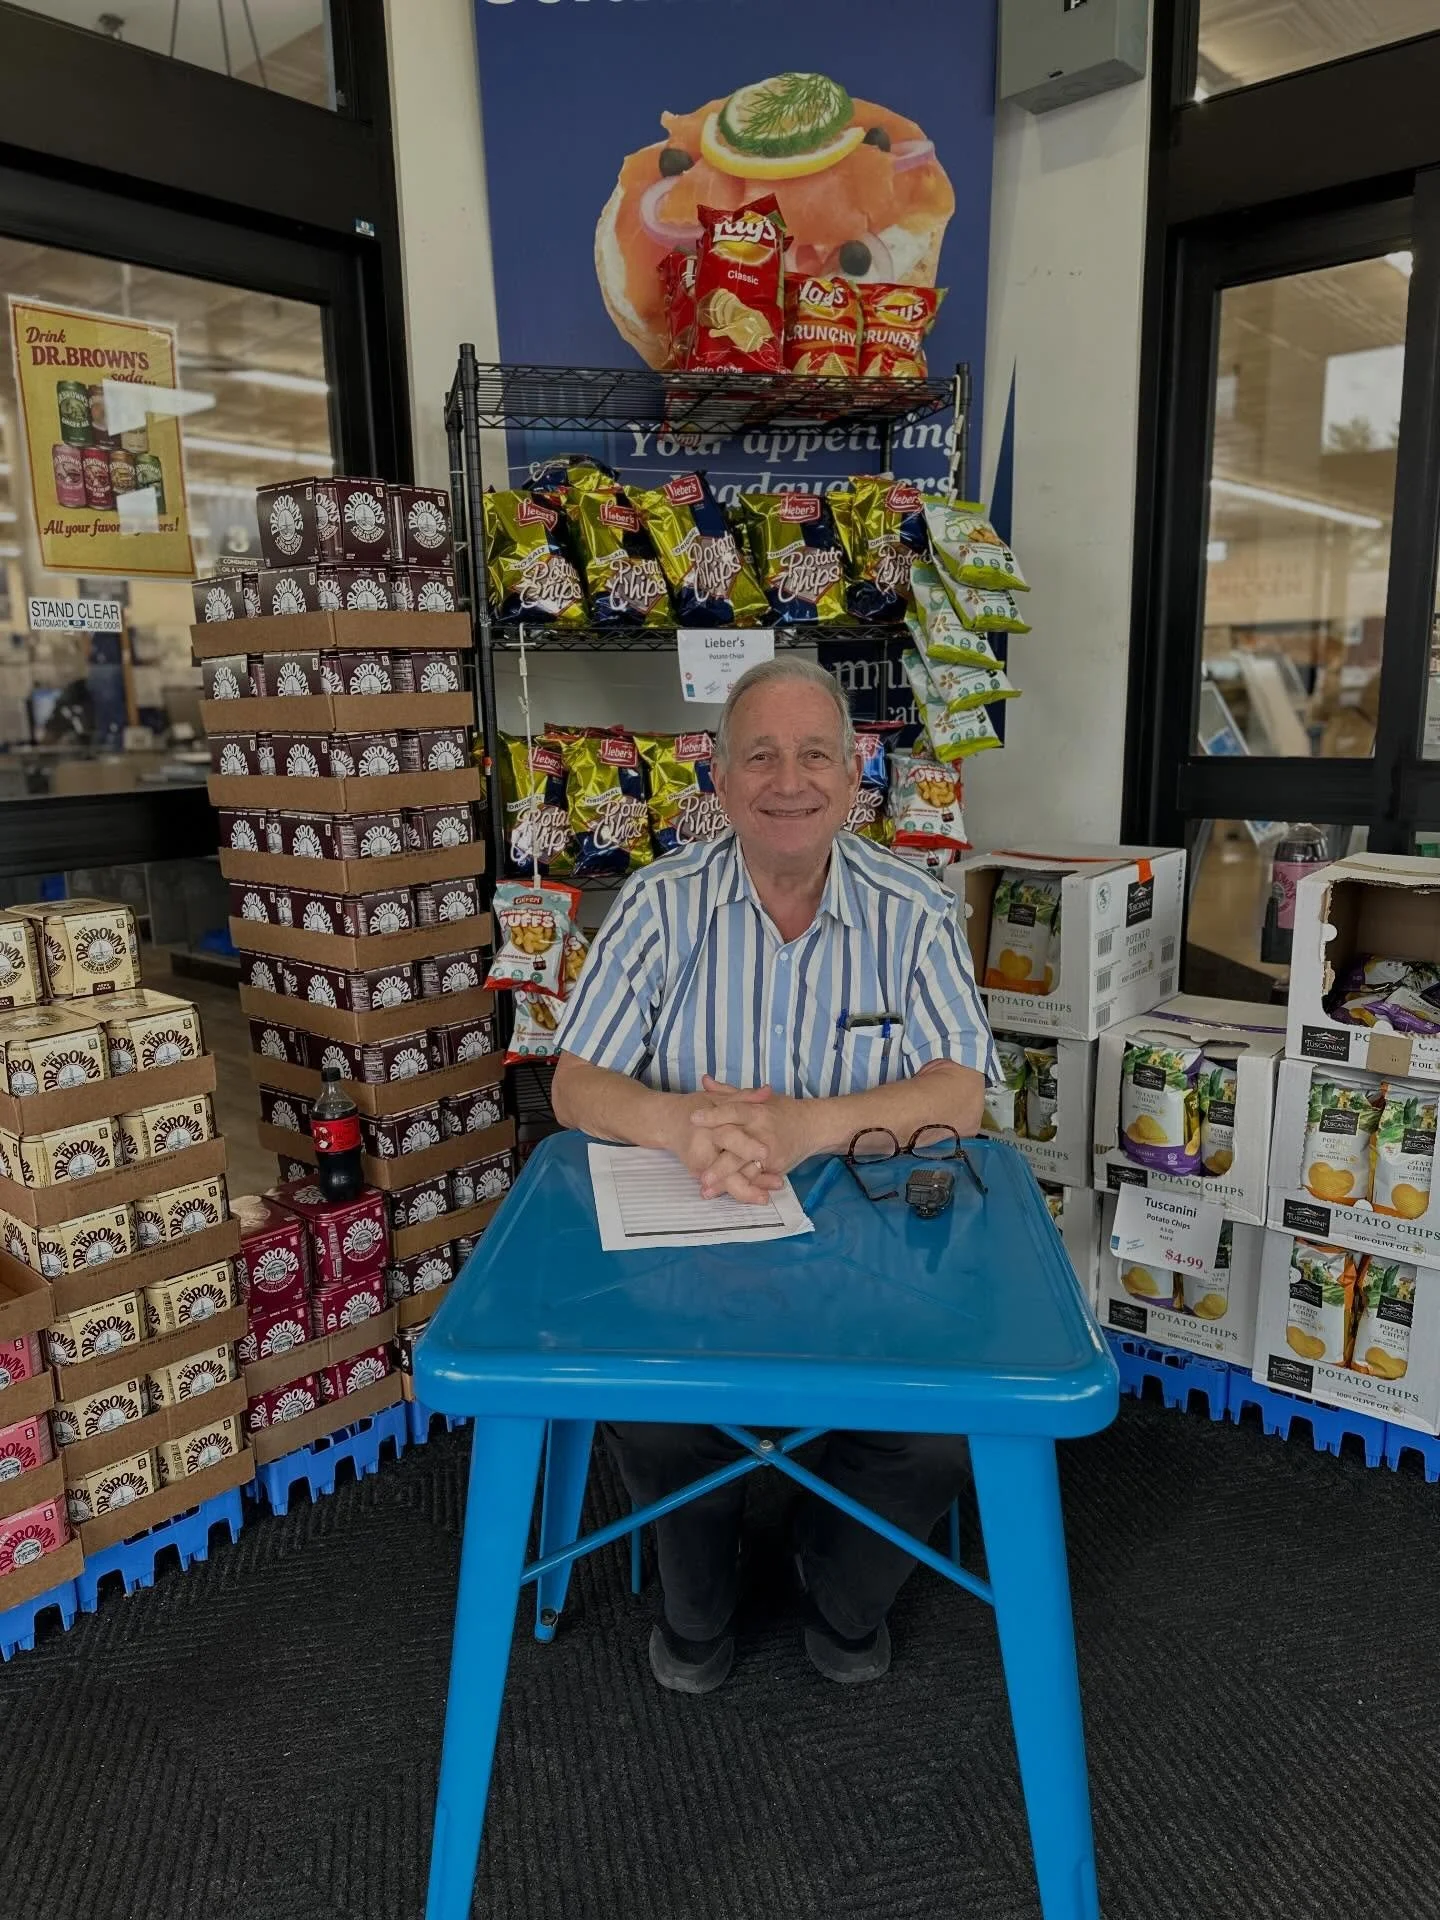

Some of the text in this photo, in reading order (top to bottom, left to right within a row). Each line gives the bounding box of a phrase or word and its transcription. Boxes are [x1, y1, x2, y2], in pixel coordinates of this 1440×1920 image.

[727, 269, 759, 285] Classic
[26, 326, 66, 344] Drink
[862, 328, 919, 351] CRUNCH
[44, 520, 64, 535] All
[66, 524, 90, 538] your
[695, 553, 741, 602] Chips
[778, 564, 840, 602] Chips
[32, 600, 119, 619] STAND CLEAR
[34, 619, 120, 629] AUTOMATIC SLIDE DOOR
[705, 637, 744, 648] Lieber's
[74, 926, 88, 940] DIET
[1126, 929, 1150, 946] POTATO
[1128, 943, 1147, 957] CHIPS
[991, 994, 1073, 1013] POTATO CHIPS
[139, 1030, 154, 1045] DIET
[1305, 1039, 1347, 1052] TUSCANINI
[40, 1051, 55, 1067] DIET
[152, 1116, 166, 1131] DIET
[52, 1142, 67, 1157] DIET
[992, 1135, 1069, 1161] POTATO CHIPS
[1151, 1171, 1244, 1197] POTATO CHIPS
[168, 1200, 181, 1216] DIET
[1145, 1196, 1197, 1218] Tuscanini
[1146, 1213, 1191, 1230] Potato Chips
[1287, 1212, 1327, 1227] TUSCANINI
[1335, 1209, 1391, 1229] POTATO
[1397, 1224, 1440, 1240] CHIPS
[70, 1230, 85, 1247] DIET
[1372, 1238, 1395, 1249] OLIVE
[1165, 1249, 1203, 1269] $4.99
[176, 1287, 189, 1303] DIET
[80, 1319, 94, 1336] DIET
[1151, 1311, 1238, 1340] POTATO CHIPS
[177, 1364, 190, 1380] DIET
[1271, 1367, 1311, 1384] TUSCANINI
[1318, 1367, 1419, 1403] POTATO CHIPS
[83, 1399, 98, 1415] DIET
[1353, 1396, 1375, 1406] OLIVE
[1376, 1401, 1389, 1410] OIL
[184, 1439, 197, 1453] DIET
[95, 1478, 109, 1495] DIET
